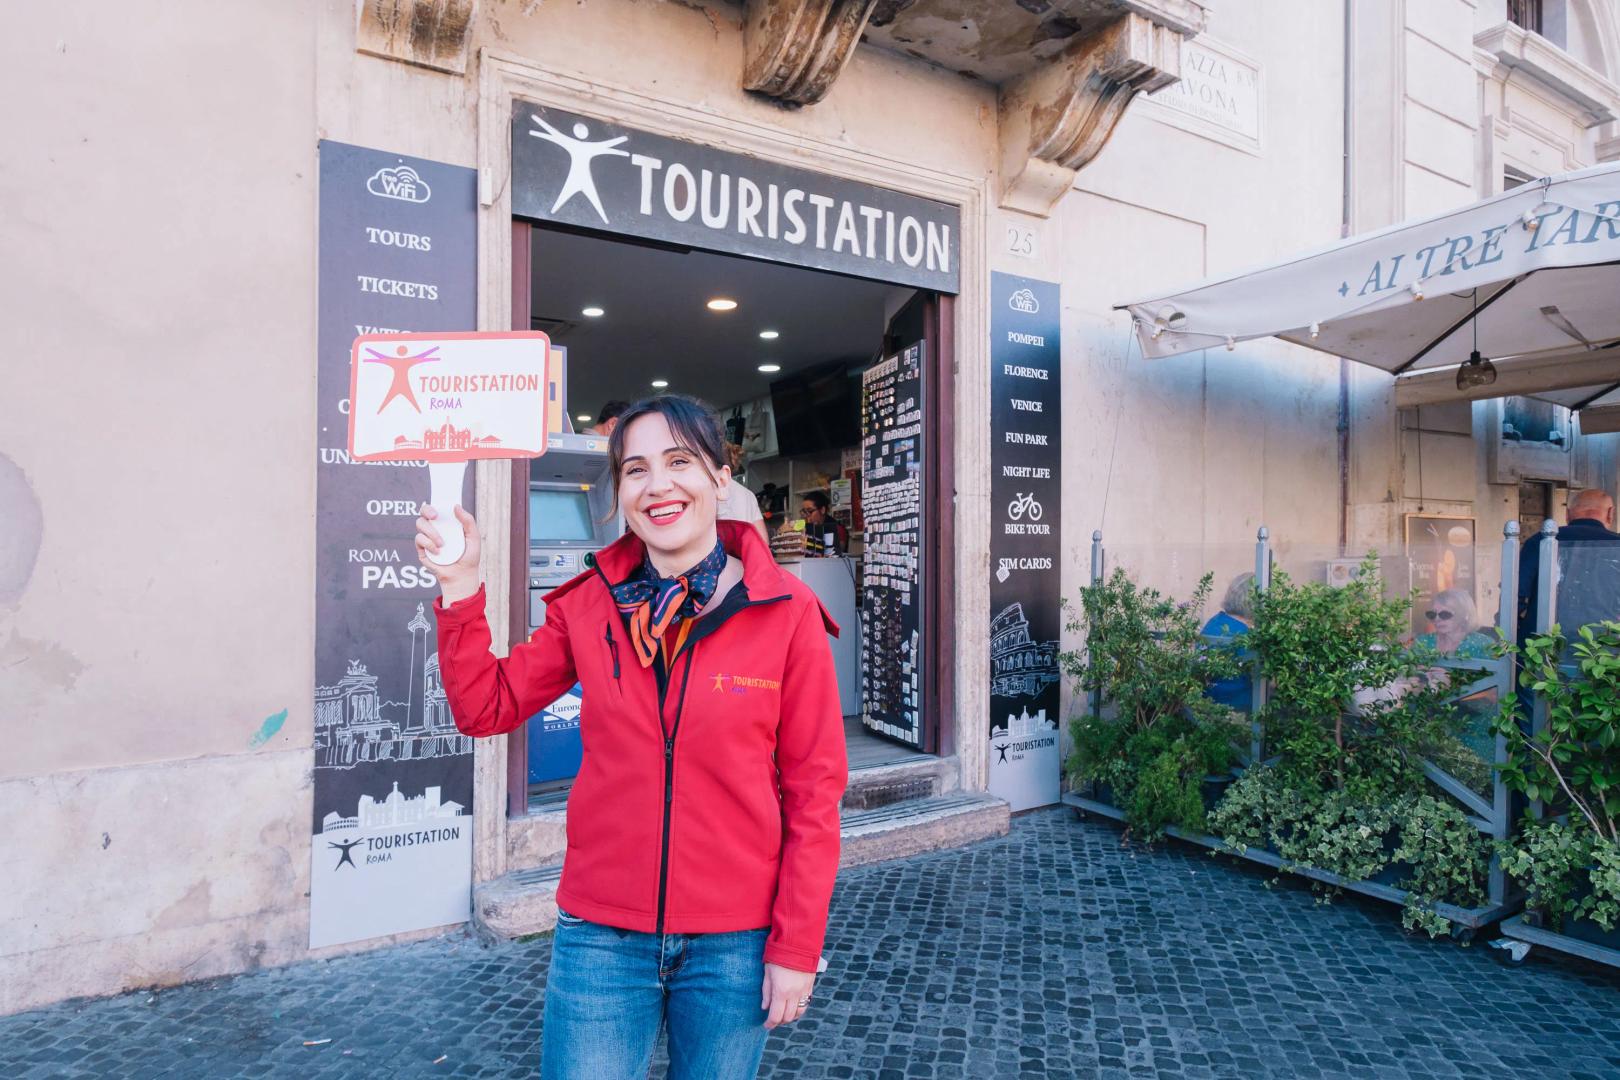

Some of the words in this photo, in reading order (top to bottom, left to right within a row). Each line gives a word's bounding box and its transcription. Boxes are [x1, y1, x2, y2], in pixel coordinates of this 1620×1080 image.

[1170, 77, 1237, 115] AVONA
[631, 153, 950, 273] TOURISTATION
[366, 227, 432, 251] TOURS
[1008, 227, 1033, 254] 25
[1358, 254, 1405, 296] AI
[1415, 224, 1508, 279] TRE
[357, 275, 439, 300] TICKETS
[1007, 331, 1044, 347] POMPEII
[1004, 364, 1048, 380] FLORENCE
[419, 374, 539, 393] TOURISTATION
[429, 397, 463, 410] ROMA
[1010, 398, 1043, 412] VENICE
[1005, 431, 1024, 444] FUN
[1025, 433, 1048, 446] PARK
[1003, 465, 1031, 478] NIGHT
[1032, 467, 1050, 479] LIFE
[1004, 523, 1025, 535] BIKE
[1026, 523, 1050, 535] TOUR
[348, 548, 401, 563] ROMA
[999, 557, 1018, 570] SIM
[1019, 557, 1052, 570] CARDS
[362, 565, 437, 589] PASS
[1012, 737, 1055, 752] TOURISTATION
[366, 826, 460, 852] TOURISTATION
[366, 852, 393, 865] ROMA
